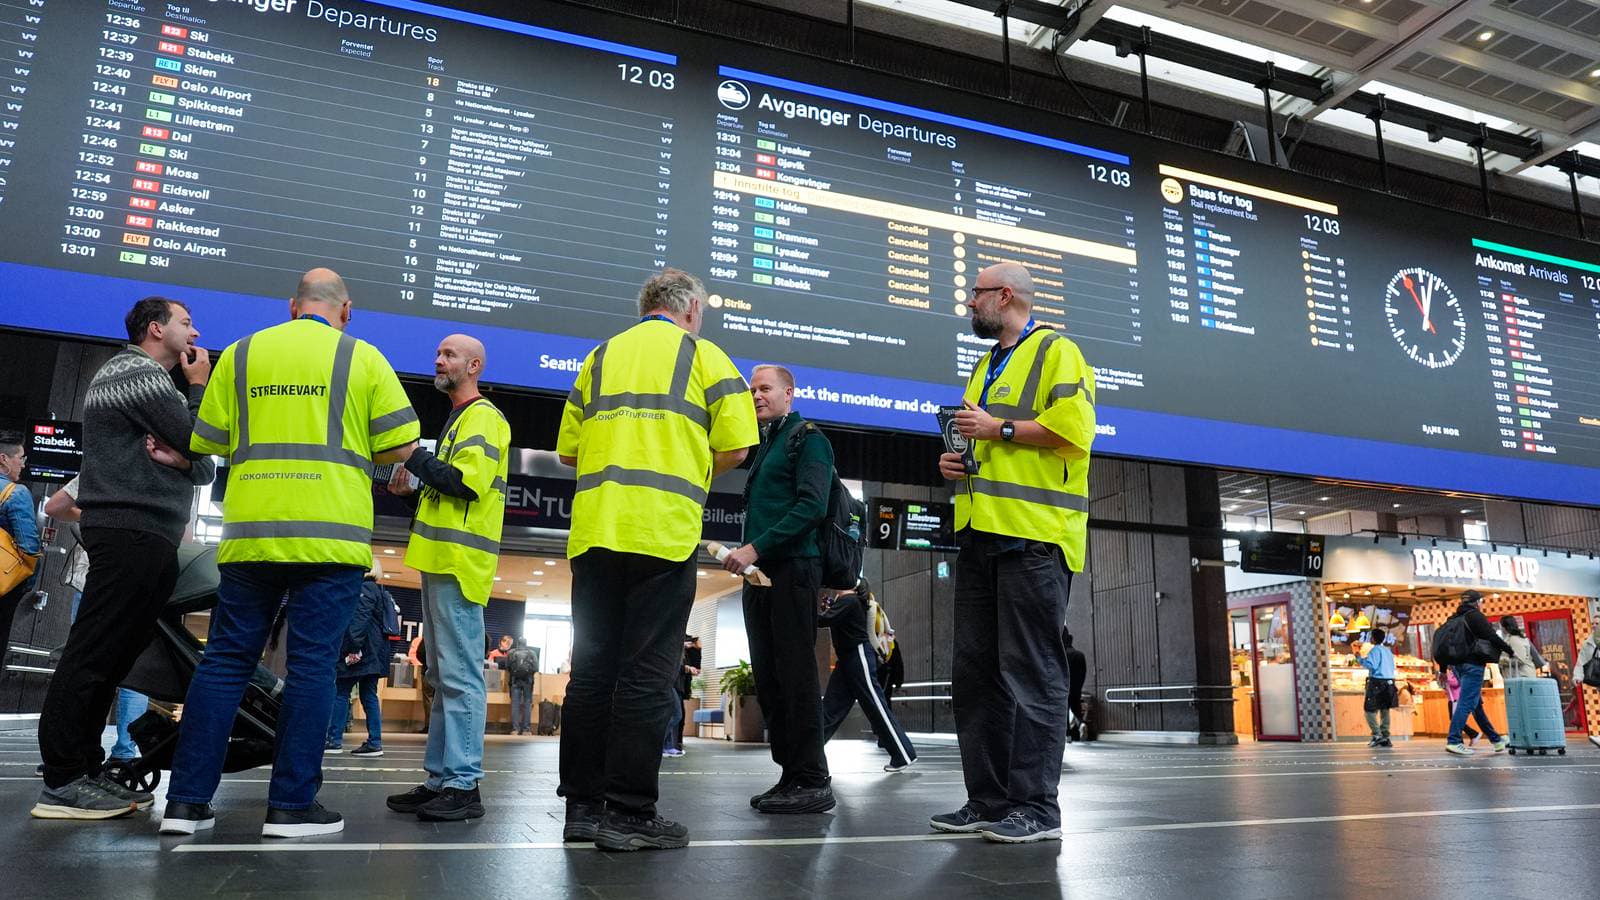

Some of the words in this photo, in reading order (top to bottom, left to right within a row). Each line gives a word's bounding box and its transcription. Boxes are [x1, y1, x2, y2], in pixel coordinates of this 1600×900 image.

[165, 11, 206, 25] Destination
[167, 4, 180, 14] Tog
[182, 6, 190, 14] til
[307, 1, 438, 42] Departures
[106, 14, 140, 28] 12:36
[190, 30, 209, 43] Ski
[427, 77, 439, 87] 18
[341, 46, 371, 58] Expected
[342, 39, 374, 51] Forventet
[428, 56, 443, 65] Spor
[99, 47, 134, 61] 12:39
[184, 64, 216, 78] Skien
[426, 108, 432, 117] 5
[103, 30, 138, 45] 12:37
[187, 48, 235, 64] Stabekk
[427, 93, 434, 102] 8
[427, 63, 445, 72] Track
[618, 63, 643, 84] 12
[649, 70, 675, 90] 03
[93, 81, 126, 95] 12:41
[178, 98, 243, 117] Spikkestad
[421, 140, 429, 149] 7
[96, 65, 131, 78] 12:40
[181, 80, 208, 93] Oslo
[211, 86, 252, 102] Airport
[420, 124, 434, 134] 13
[89, 99, 123, 113] 12:41
[175, 114, 234, 133] Lillestrøm
[419, 156, 427, 165] 9
[758, 93, 851, 126] Avganger
[858, 113, 957, 148] Departures
[86, 116, 120, 131] 12:44
[172, 131, 192, 143] Dal
[414, 172, 427, 182] 11
[716, 132, 740, 143] 13:01
[777, 144, 811, 157] Lysaker
[954, 179, 961, 187] 7
[82, 134, 117, 147] 12:46
[169, 149, 188, 160] Ski
[412, 188, 426, 199] 10
[716, 146, 741, 158] 13:04
[777, 158, 805, 170] Gjøvik
[955, 193, 961, 201] 6
[1088, 164, 1107, 183] 12
[1111, 169, 1130, 187] 03
[79, 152, 114, 166] 12:52
[166, 166, 199, 180] Moss
[410, 205, 424, 215] 12
[715, 161, 740, 173] 13:04
[777, 172, 831, 190] Kongsvinger
[953, 206, 963, 215] 11
[782, 188, 800, 200] tog
[1189, 184, 1216, 201] Buss
[1218, 191, 1233, 204] for
[1234, 195, 1252, 211] tog
[75, 170, 111, 184] 12:54
[163, 184, 210, 200] Eidsvoll
[408, 222, 421, 232] 11
[1191, 199, 1204, 208] Rail
[1205, 202, 1244, 218] replacement
[1245, 211, 1257, 221] bus
[72, 188, 107, 201] 12:59
[159, 202, 195, 215] Asker
[409, 239, 416, 249] 5
[776, 201, 808, 214] Halden
[888, 221, 928, 236] Cancelled
[776, 216, 790, 226] Ski
[888, 236, 929, 250] Cancelled
[1304, 214, 1321, 232] 12
[1323, 217, 1340, 235] 03
[68, 206, 104, 220] 13:00
[156, 220, 219, 237] Rakkestad
[404, 256, 418, 266] 16
[775, 231, 818, 246] Drammen
[888, 250, 929, 265] Cancelled
[64, 225, 100, 238] 13:00
[153, 238, 181, 250] Oslo
[184, 242, 226, 257] Airport
[402, 273, 416, 283] 13
[775, 246, 810, 259] Lysaker
[888, 265, 929, 280] Cancelled
[1475, 253, 1526, 276] Ankomst
[1529, 265, 1568, 284] Arrivals
[61, 243, 96, 256] 13:01
[150, 256, 169, 267] Ski
[400, 290, 414, 300] 10
[774, 261, 830, 278] Lillehammer
[888, 280, 929, 294] Cancelled
[1581, 276, 1596, 290] 12
[724, 298, 752, 310] Strike
[774, 276, 811, 291] Stabekk
[888, 294, 930, 309] Cancelled
[723, 313, 746, 323] Please
[747, 317, 762, 325] note
[763, 319, 777, 327] that
[778, 321, 799, 331] delays
[751, 325, 764, 333] See
[794, 332, 811, 340] more
[250, 384, 326, 398] STREIKEVAKT
[817, 388, 839, 402] the
[842, 393, 893, 408] monitor
[894, 399, 918, 413] and
[1096, 424, 1116, 435] eats
[34, 435, 76, 447] Stabekk
[240, 472, 322, 481] LOKOMOTIVFØRER
[506, 486, 571, 518] ENTU
[880, 523, 890, 540] 9
[1307, 555, 1321, 570] 10
[1413, 549, 1477, 578] BAKE
[1480, 553, 1512, 580] ME
[1512, 556, 1539, 583] UP
